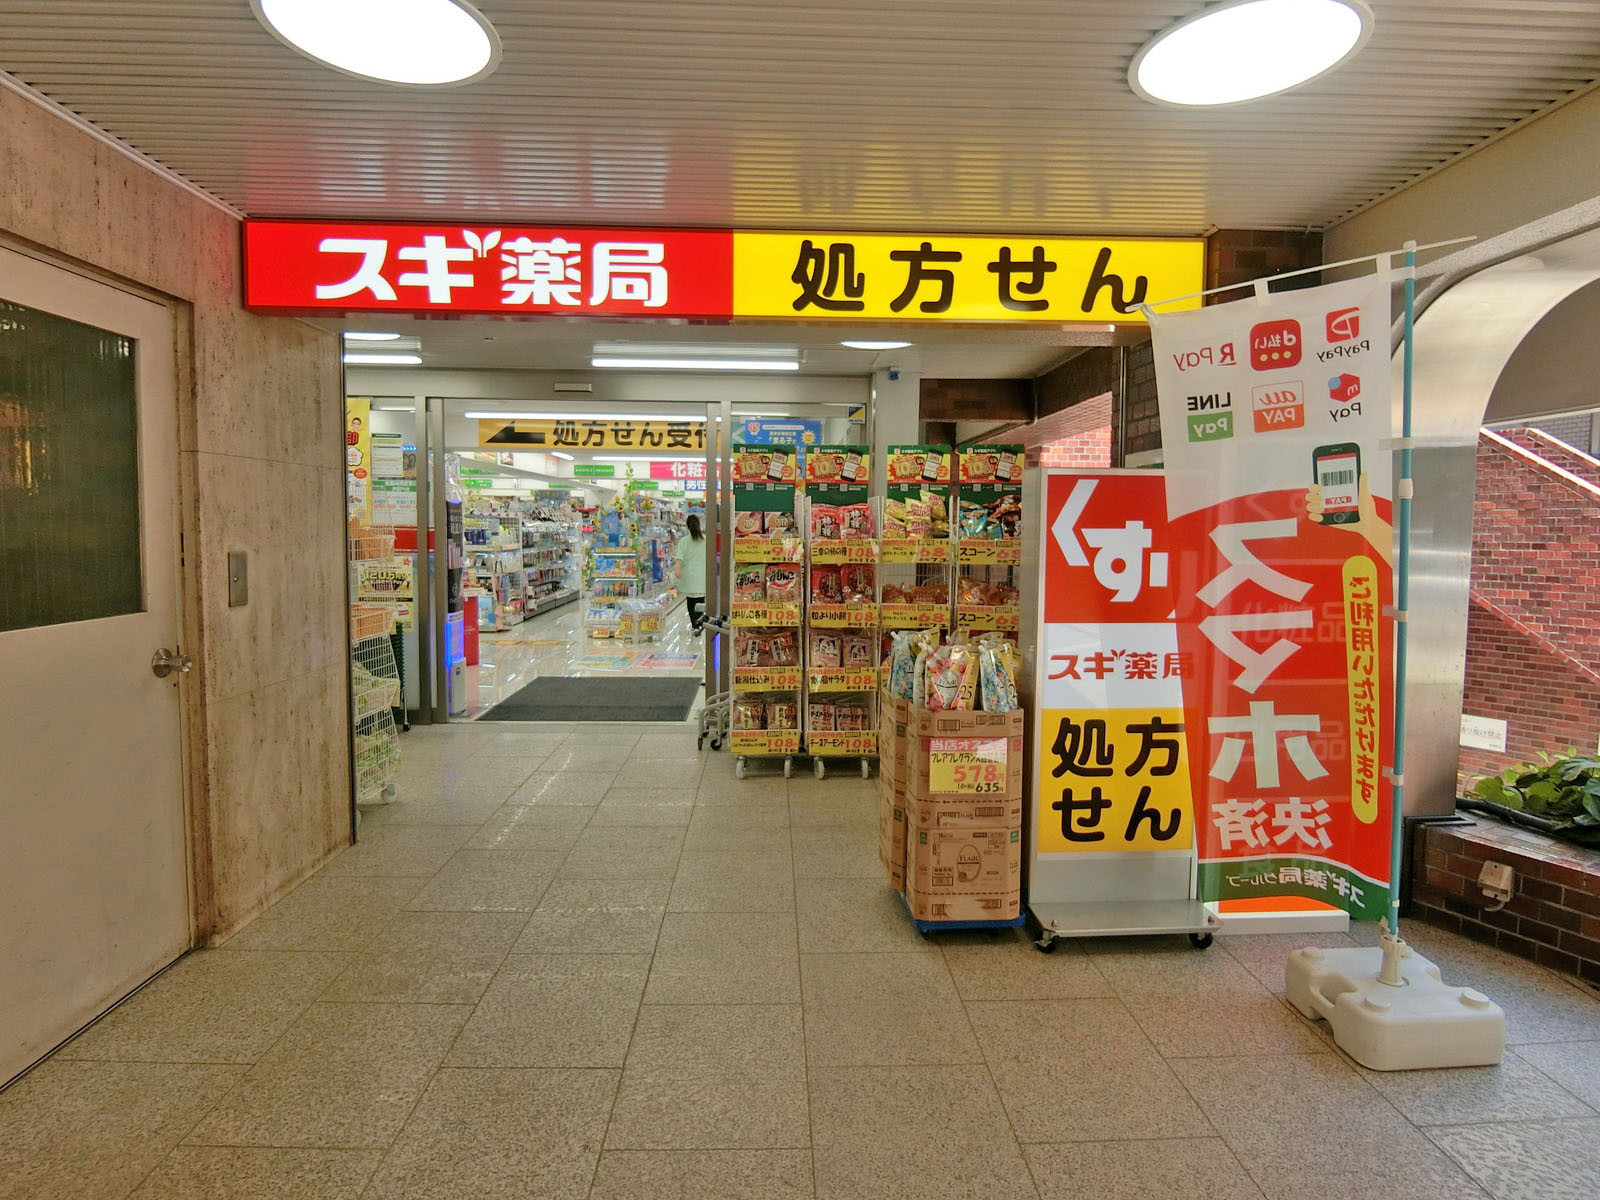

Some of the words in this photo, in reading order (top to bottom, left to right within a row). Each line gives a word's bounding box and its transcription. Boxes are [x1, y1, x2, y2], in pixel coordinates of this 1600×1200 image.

[315, 231, 668, 307] スギ薬局
[791, 240, 1148, 314] 処方せん
[959, 547, 996, 557] スコーン
[958, 613, 995, 623] スコーン
[1048, 649, 1194, 680] スギ薬局
[1051, 716, 1185, 778] 処方
[1052, 786, 1182, 842] せん
